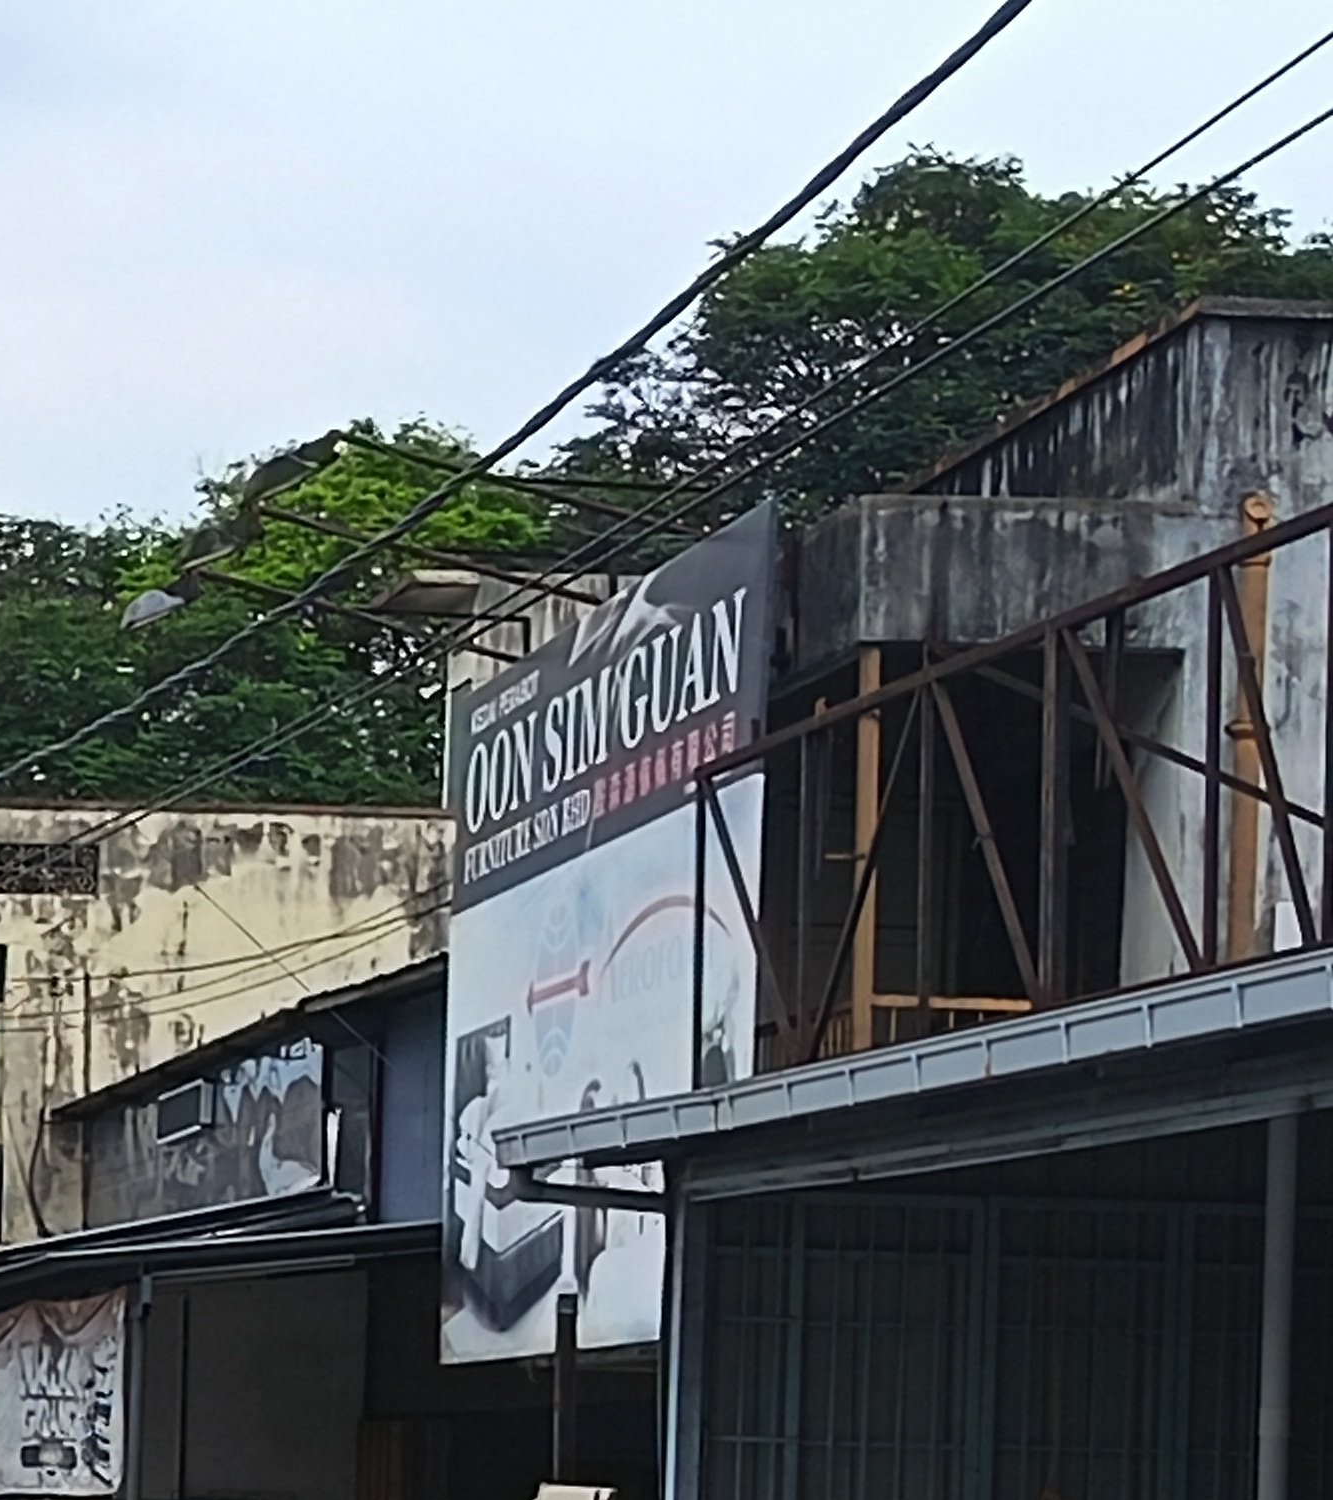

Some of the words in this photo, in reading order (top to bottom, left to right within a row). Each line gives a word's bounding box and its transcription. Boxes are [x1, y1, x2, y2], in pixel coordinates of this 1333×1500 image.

[465, 709, 538, 834] OON
[541, 666, 612, 793] SIM
[616, 587, 747, 750] GUAN
